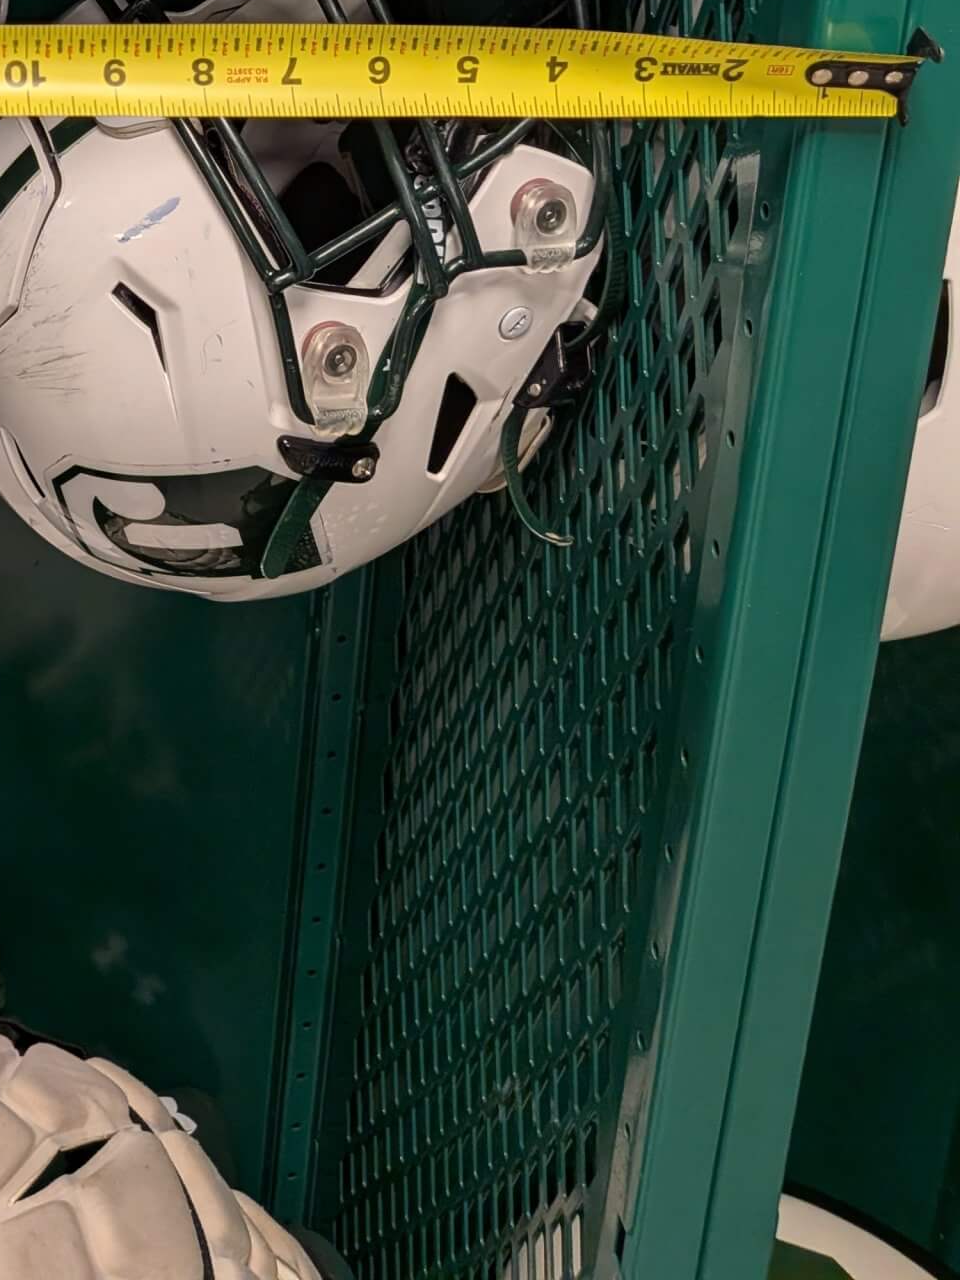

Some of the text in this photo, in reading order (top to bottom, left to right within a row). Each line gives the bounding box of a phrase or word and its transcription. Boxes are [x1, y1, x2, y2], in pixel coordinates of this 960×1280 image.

[4, 60, 47, 87] 10
[103, 59, 126, 87] 9
[191, 57, 215, 86] 8
[281, 57, 303, 85] 7
[368, 56, 390, 84] 6
[456, 56, 480, 83] 5
[546, 56, 569, 82] 4
[635, 56, 658, 82] 3
[722, 59, 749, 82] 2
